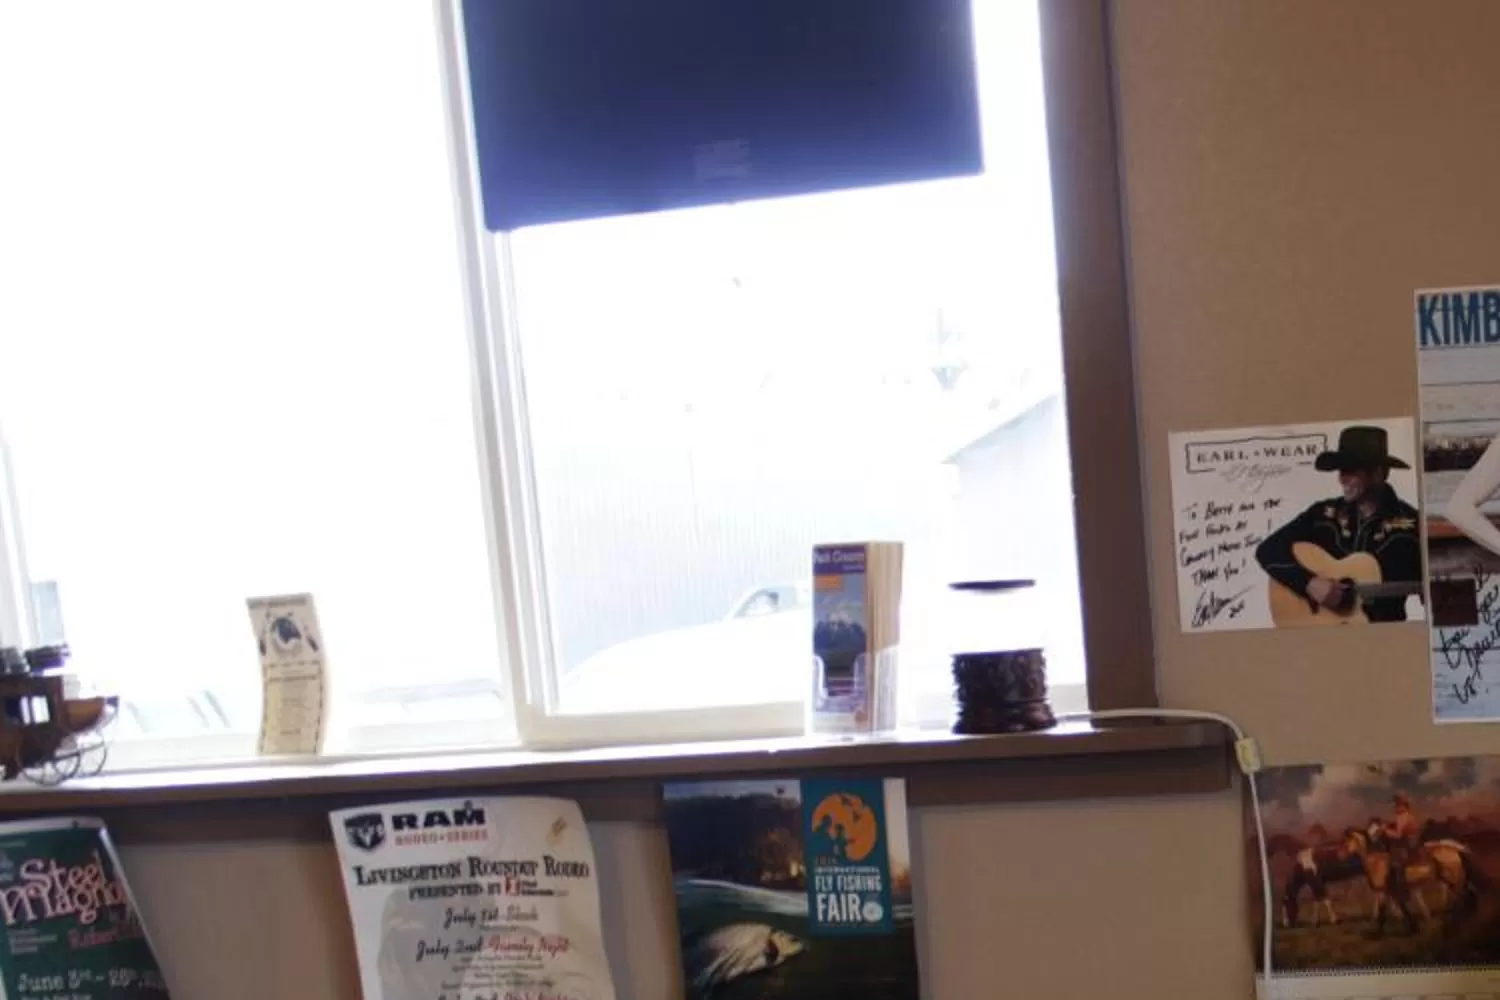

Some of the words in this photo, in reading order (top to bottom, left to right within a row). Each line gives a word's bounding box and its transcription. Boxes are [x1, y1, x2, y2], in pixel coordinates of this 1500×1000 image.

[1196, 448, 1249, 463] EARL
[1263, 444, 1318, 457] WEAR
[391, 808, 486, 831] RAM
[19, 848, 108, 889] Steel
[353, 861, 461, 887] LIVINGSTON
[814, 875, 834, 892] FLY
[836, 874, 883, 892] FISHING
[815, 893, 862, 923] FAIR
[17, 972, 64, 993] June
